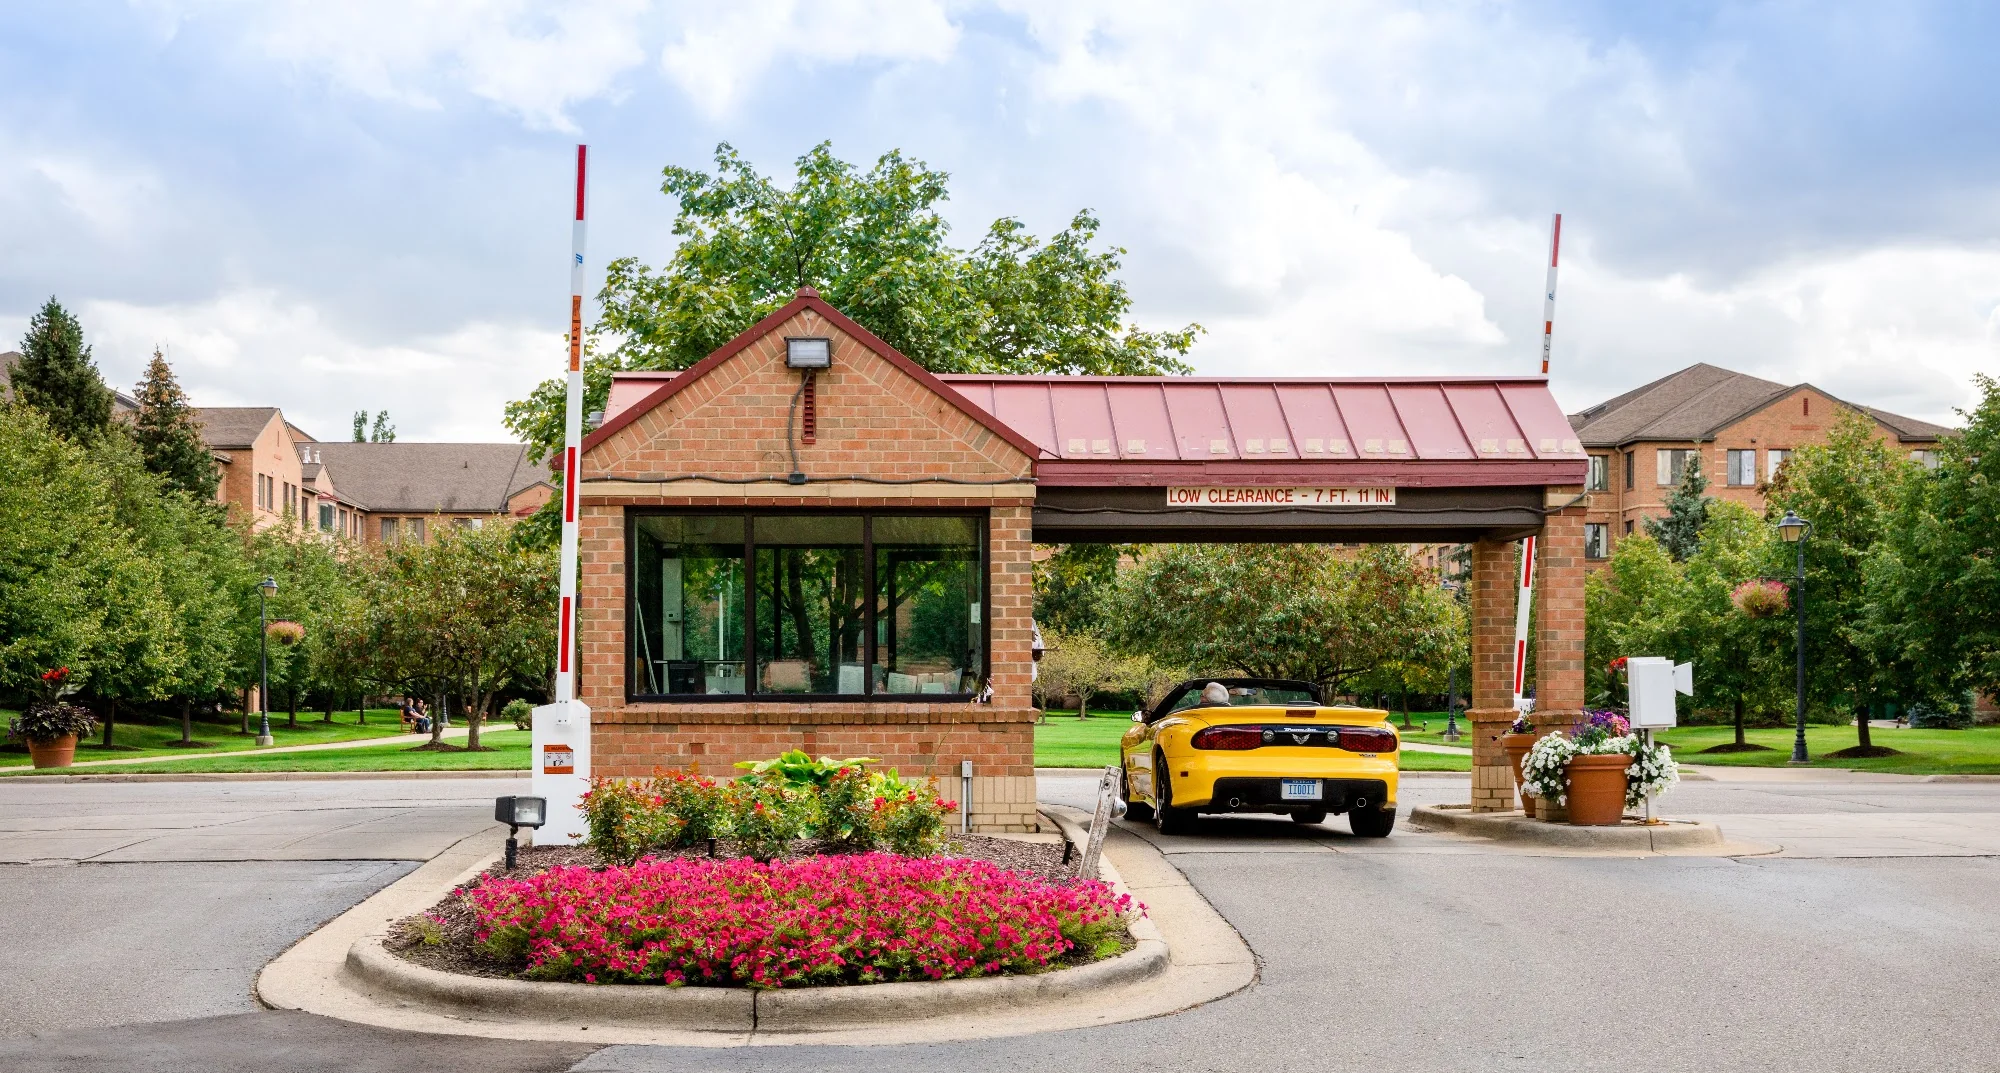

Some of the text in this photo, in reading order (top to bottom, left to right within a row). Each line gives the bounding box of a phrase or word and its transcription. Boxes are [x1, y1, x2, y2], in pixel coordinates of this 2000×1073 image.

[1169, 489, 1201, 503] LOW
[1208, 489, 1294, 503] CLEARANCE
[1315, 489, 1324, 502] 7
[1329, 489, 1351, 502] FT.
[1357, 489, 1369, 502] 11
[1375, 489, 1392, 502] IN.
